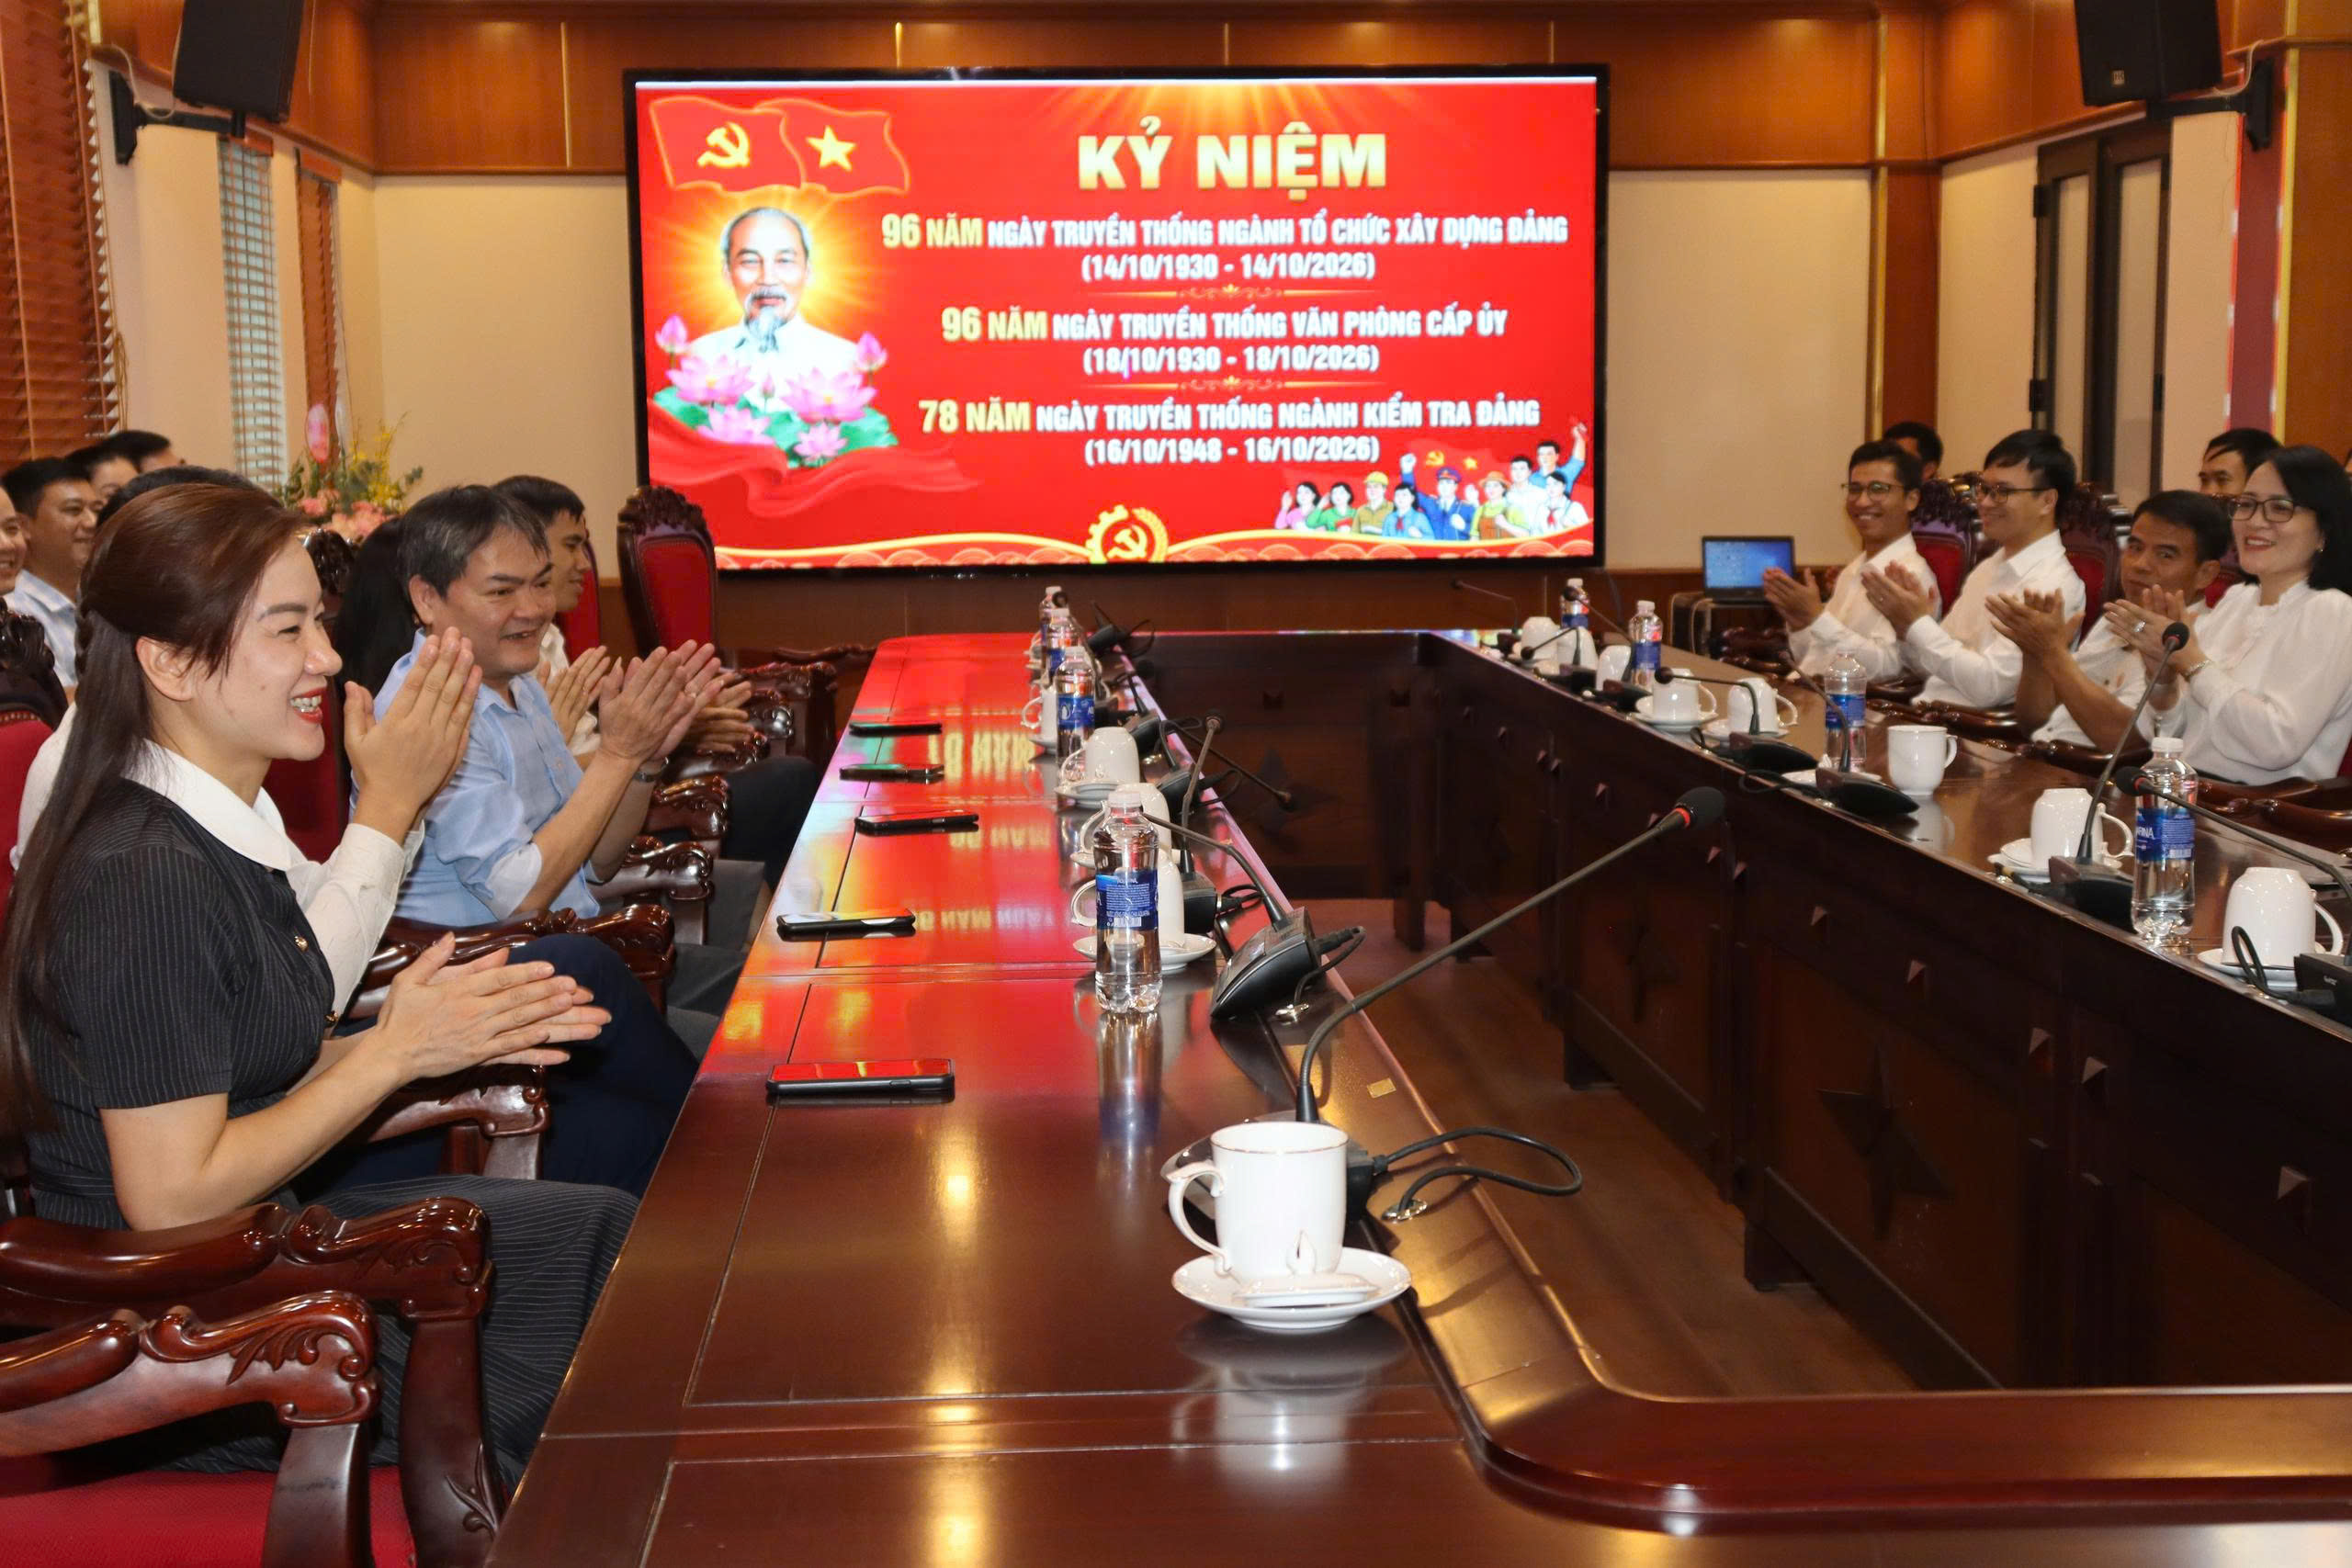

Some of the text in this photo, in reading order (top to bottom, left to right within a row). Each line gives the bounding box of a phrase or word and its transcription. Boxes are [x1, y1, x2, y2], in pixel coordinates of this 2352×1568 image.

[1078, 116, 1386, 200] KỶ NIỆM
[882, 213, 922, 248] 96
[925, 212, 983, 247] NĂM
[987, 215, 1047, 247] NGÀY
[1140, 210, 1214, 246] THỐNG
[1217, 213, 1295, 245] NGÀNH
[1299, 208, 1328, 245] TỔ
[1331, 212, 1391, 244] CHỨC
[1395, 211, 1440, 244] XÂY
[1442, 214, 1504, 248] DỰNG
[1507, 208, 1569, 243] ĐẢNG
[1080, 254, 1219, 282] (14/10/1930
[1240, 253, 1376, 279] 14/10/2026)
[942, 306, 982, 341] 96
[988, 305, 1048, 340] NĂM
[1052, 308, 1114, 340] NGÀY
[1211, 304, 1287, 338] THỐNG
[1291, 306, 1339, 338] VĂN
[1343, 305, 1421, 337] PHÒNG
[1426, 301, 1473, 336] CẤP
[1476, 301, 1509, 336] ỦY
[1082, 346, 1222, 378] (18/10/1930
[1243, 344, 1381, 372] 18/10/2026)
[918, 399, 959, 433] 78
[966, 396, 1031, 432] NĂM
[1035, 400, 1099, 432] NGÀY
[1196, 395, 1273, 429] THỐNG
[1278, 397, 1359, 428] NGÀNH
[1363, 391, 1423, 428] KIỂM
[1427, 400, 1472, 427] TRA
[1476, 392, 1541, 427] ĐẢNG
[1084, 438, 1223, 466] (16/10/1948
[1244, 436, 1380, 463] 16/10/2026)
